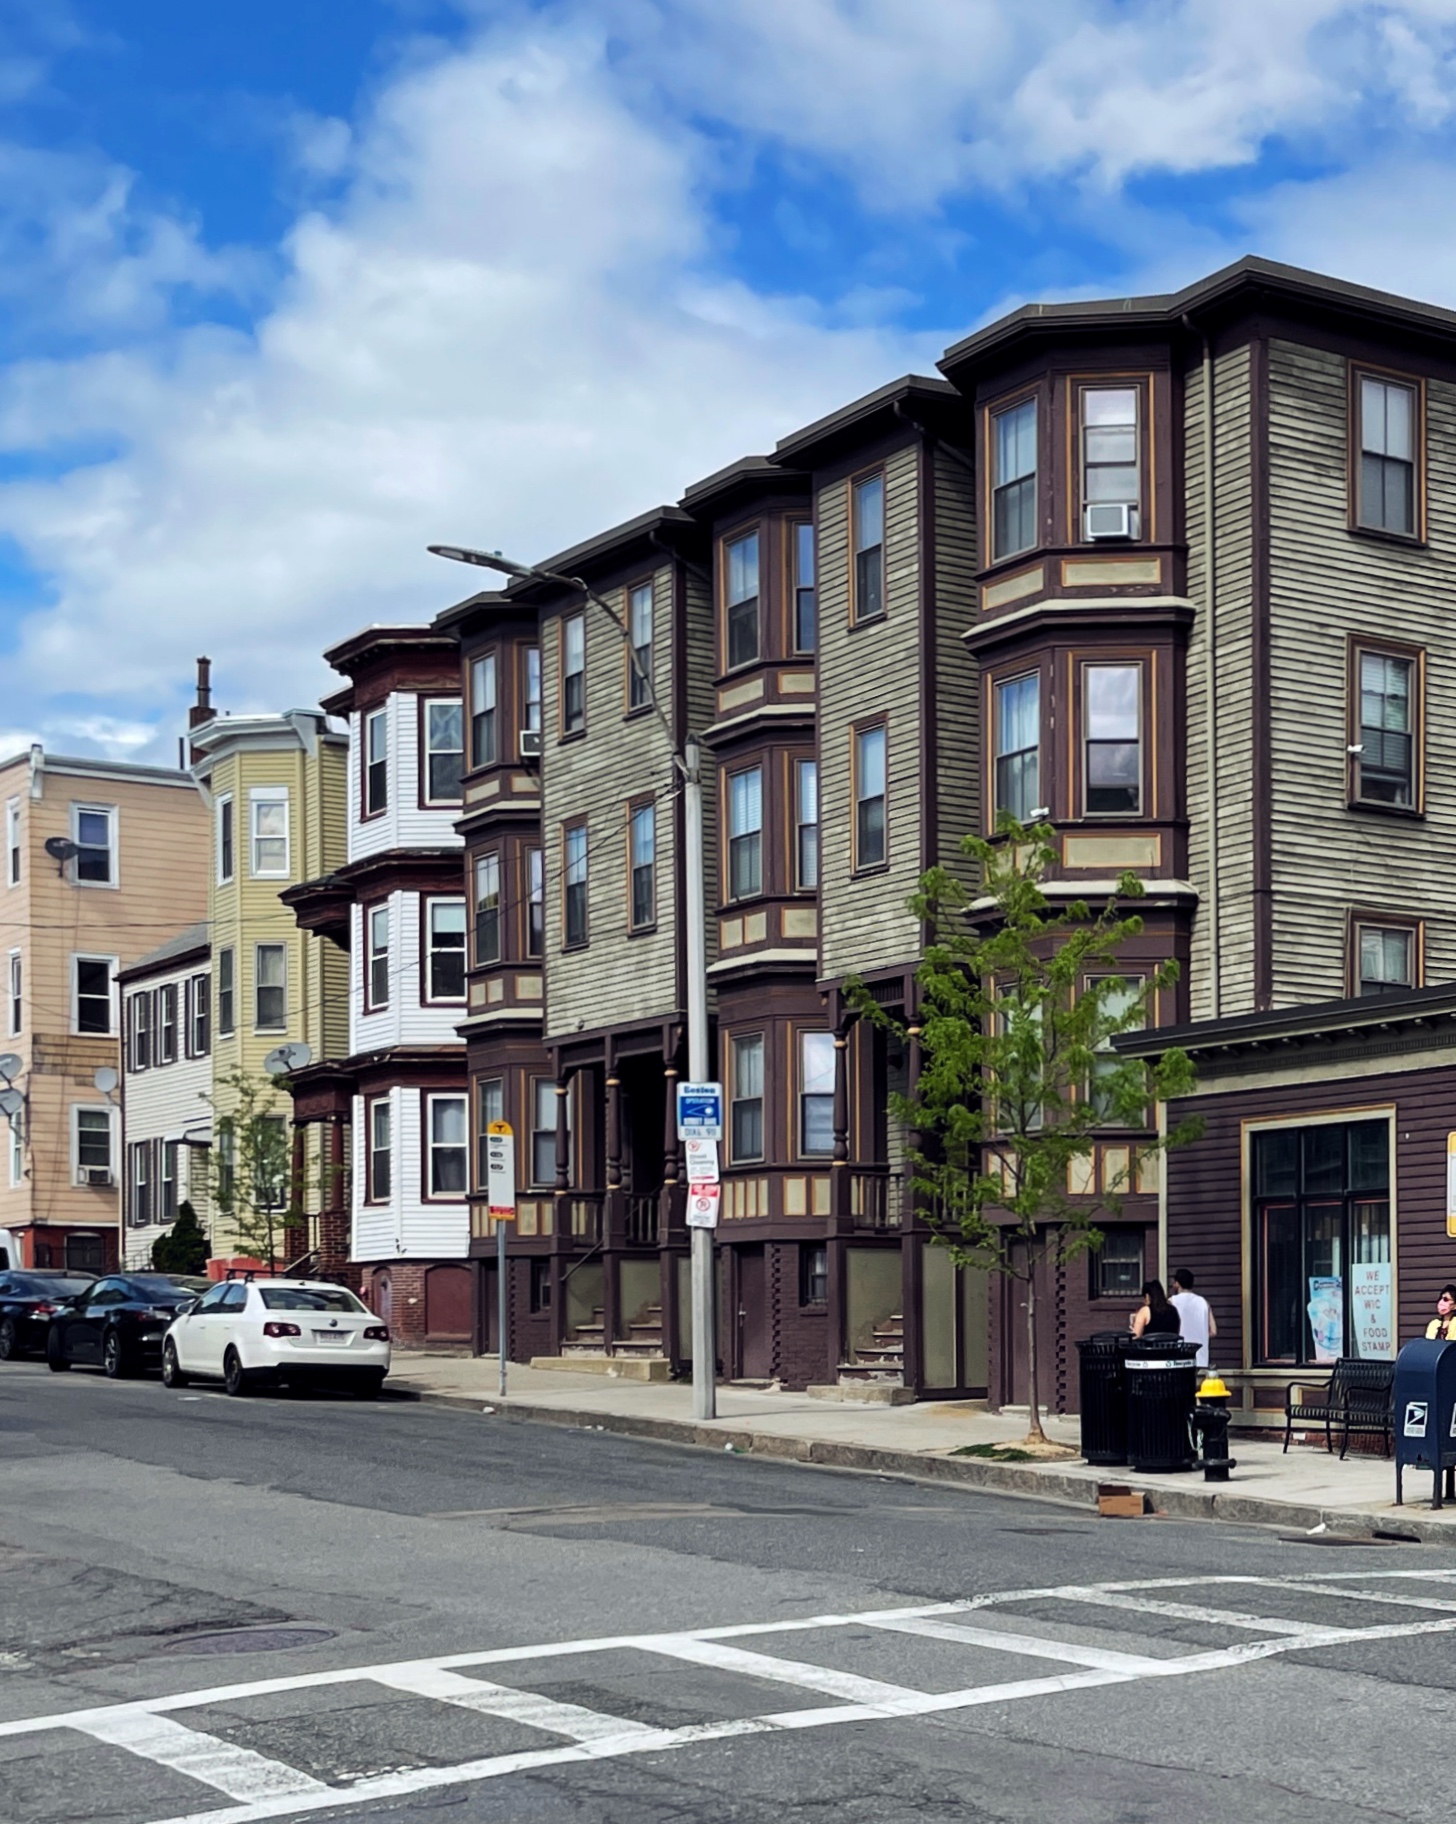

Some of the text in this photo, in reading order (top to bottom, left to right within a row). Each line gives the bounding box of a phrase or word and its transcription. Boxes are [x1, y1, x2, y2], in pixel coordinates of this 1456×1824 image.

[1366, 1271, 1380, 1280] WE
[1354, 1285, 1390, 1295] ACCEPT
[1364, 1300, 1381, 1310] WIC
[1370, 1314, 1376, 1324] &
[1364, 1328, 1388, 1338] FOOD
[1362, 1342, 1390, 1352] STAMP
